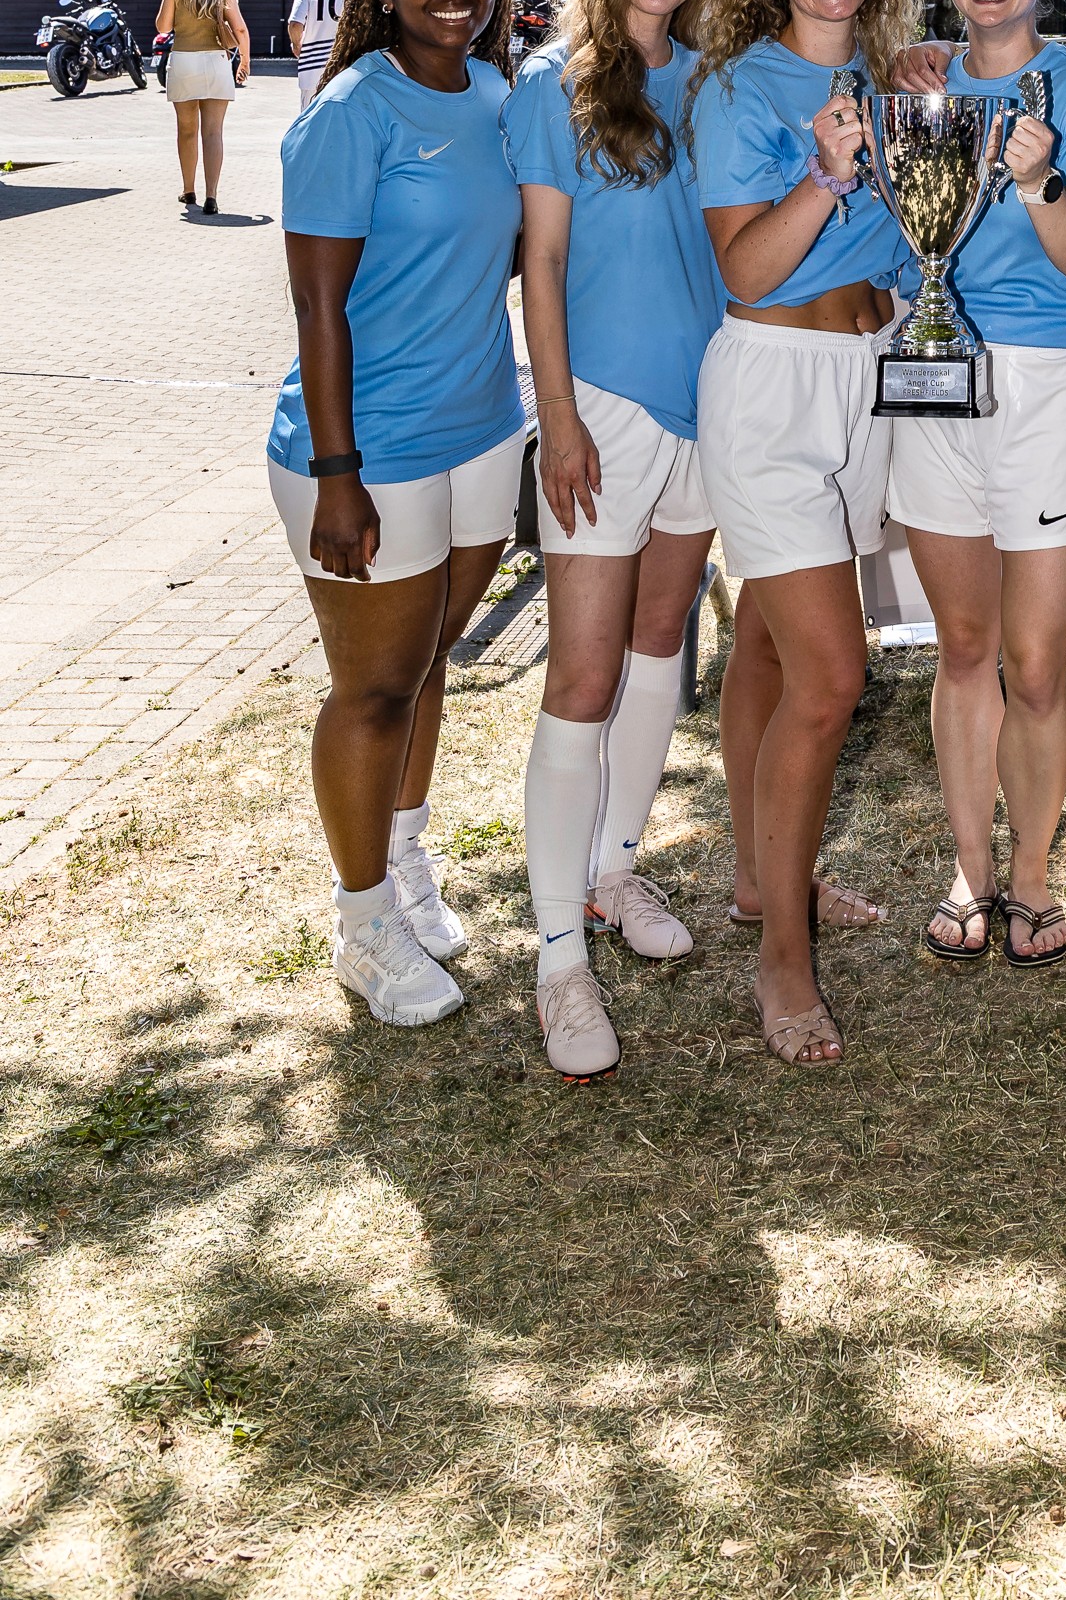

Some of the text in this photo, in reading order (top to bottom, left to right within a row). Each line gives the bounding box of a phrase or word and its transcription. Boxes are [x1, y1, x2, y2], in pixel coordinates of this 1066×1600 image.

[902, 368, 950, 377] Wanderpokal
[907, 379, 945, 388] Angel Cup
[902, 388, 949, 397] FRESHFIELDS
